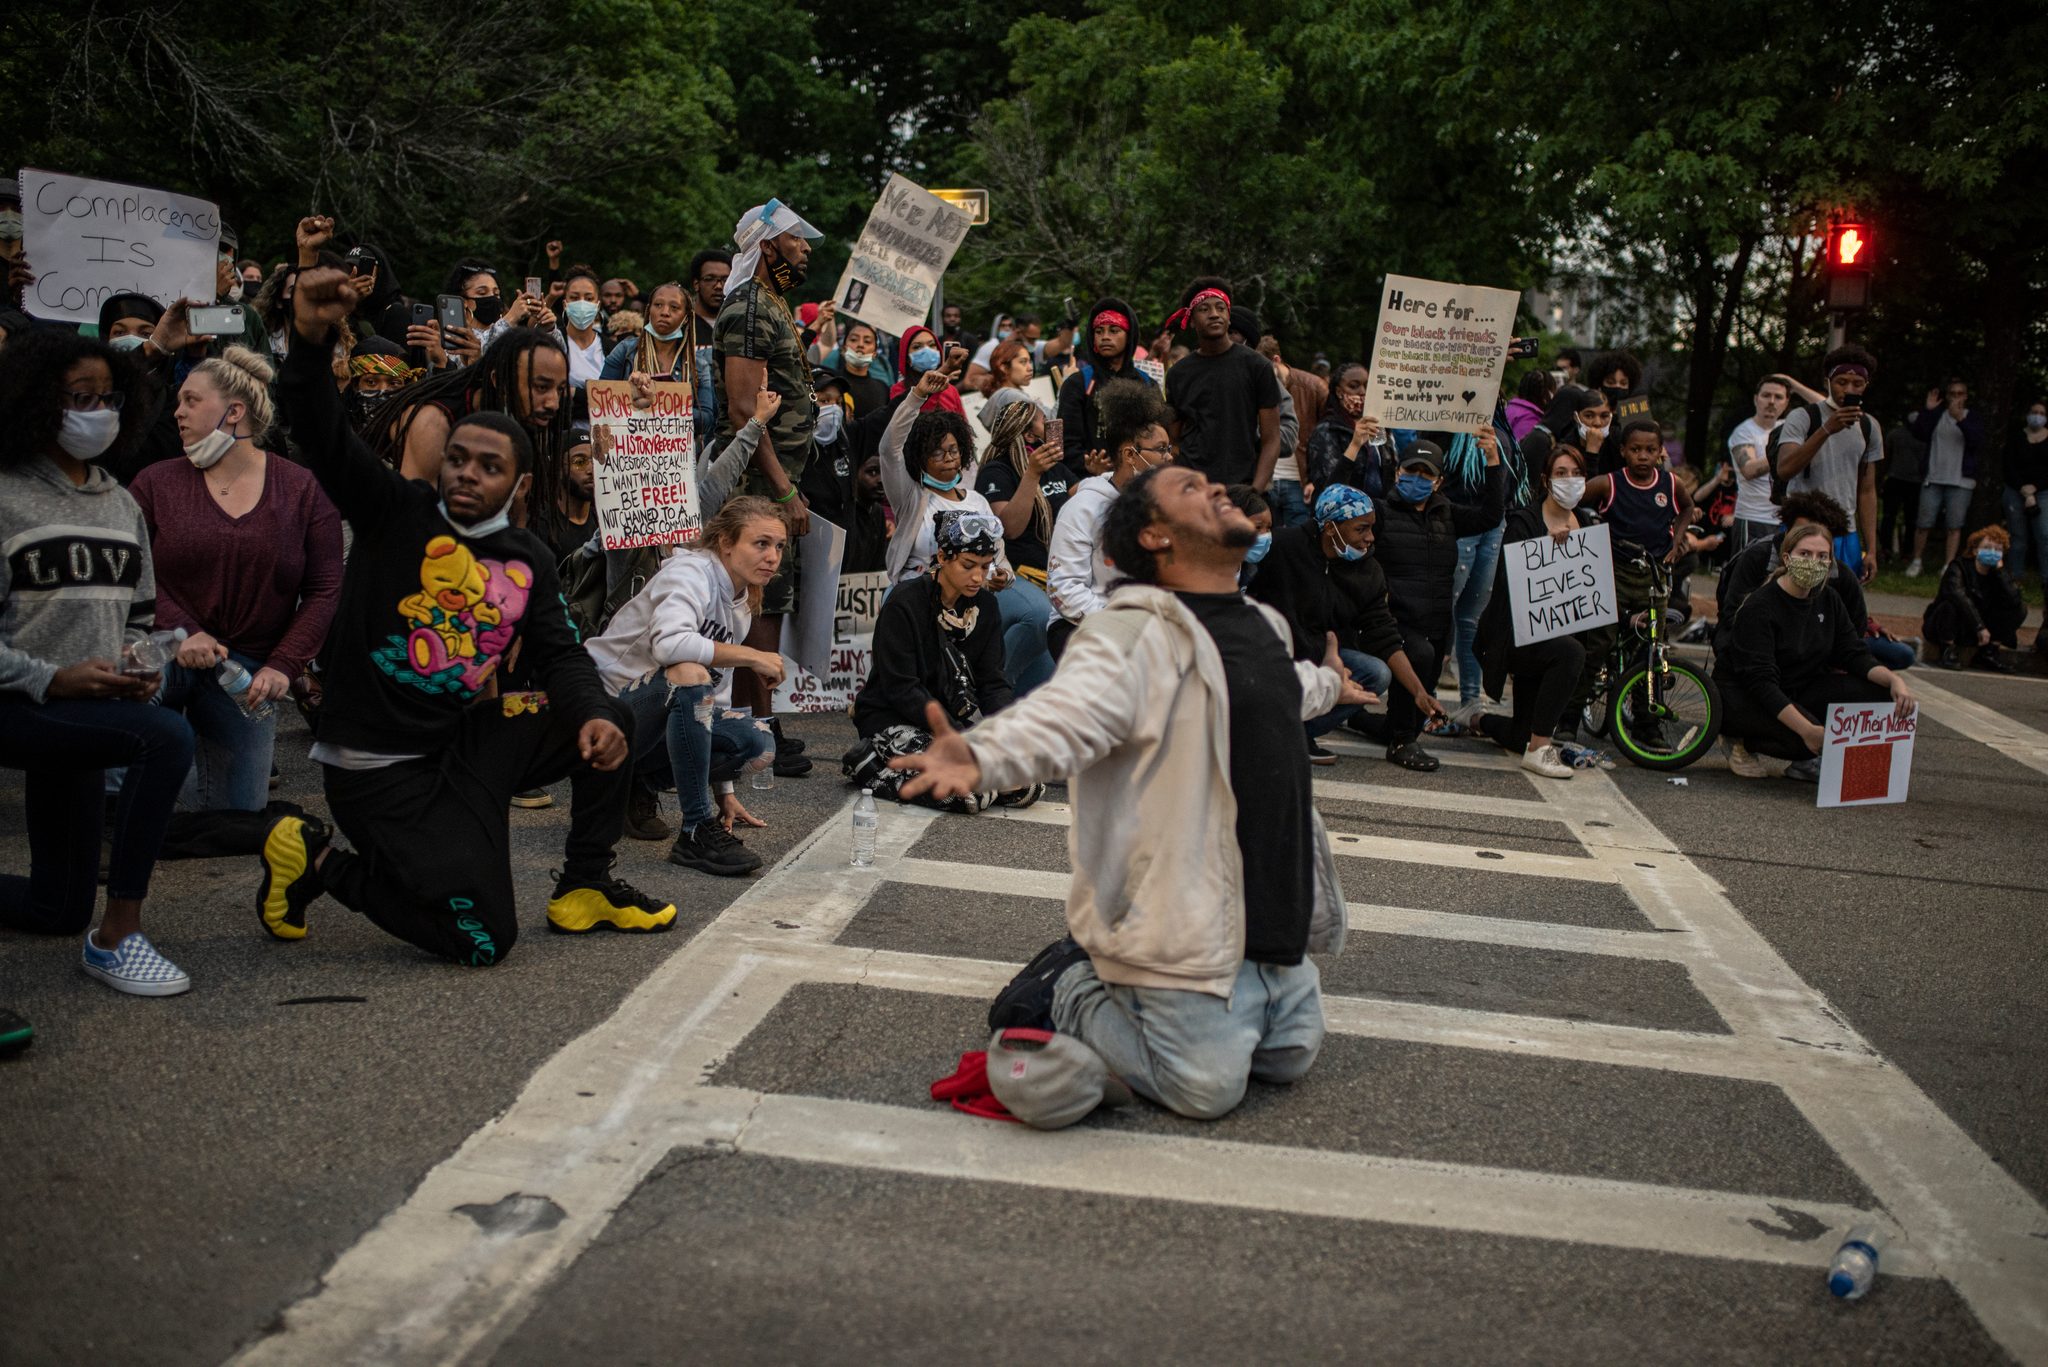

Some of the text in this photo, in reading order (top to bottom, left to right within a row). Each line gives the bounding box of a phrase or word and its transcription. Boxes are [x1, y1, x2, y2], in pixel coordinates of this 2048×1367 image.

[36, 181, 220, 240] Complacency
[81, 235, 155, 267] IS
[1387, 289, 1438, 318] Here
[1403, 339, 1432, 350] black
[1410, 325, 1446, 341] black
[1447, 326, 1498, 345] friends
[1399, 361, 1428, 374] black
[1429, 363, 1492, 379] teachers
[1401, 350, 1431, 361] black
[1432, 352, 1496, 369] neighbors
[1377, 374, 1445, 392] I see you.
[650, 390, 693, 417] PEOPLE
[1406, 391, 1433, 403] with
[1435, 393, 1455, 406] you
[603, 455, 651, 474] ANCESTORS
[599, 476, 611, 495] I
[612, 472, 639, 491] WANT
[651, 471, 669, 487] KIDS
[669, 472, 682, 483] TO
[620, 481, 688, 511] BE FREE!!
[602, 505, 688, 529] NOT CHAINED TO A
[1521, 532, 1599, 571] BLACK
[1527, 564, 1596, 604] LIVES
[1528, 590, 1611, 637] MATTER
[795, 676, 817, 693] US
[1830, 705, 1859, 737] Say
[1858, 710, 1887, 735] Their
